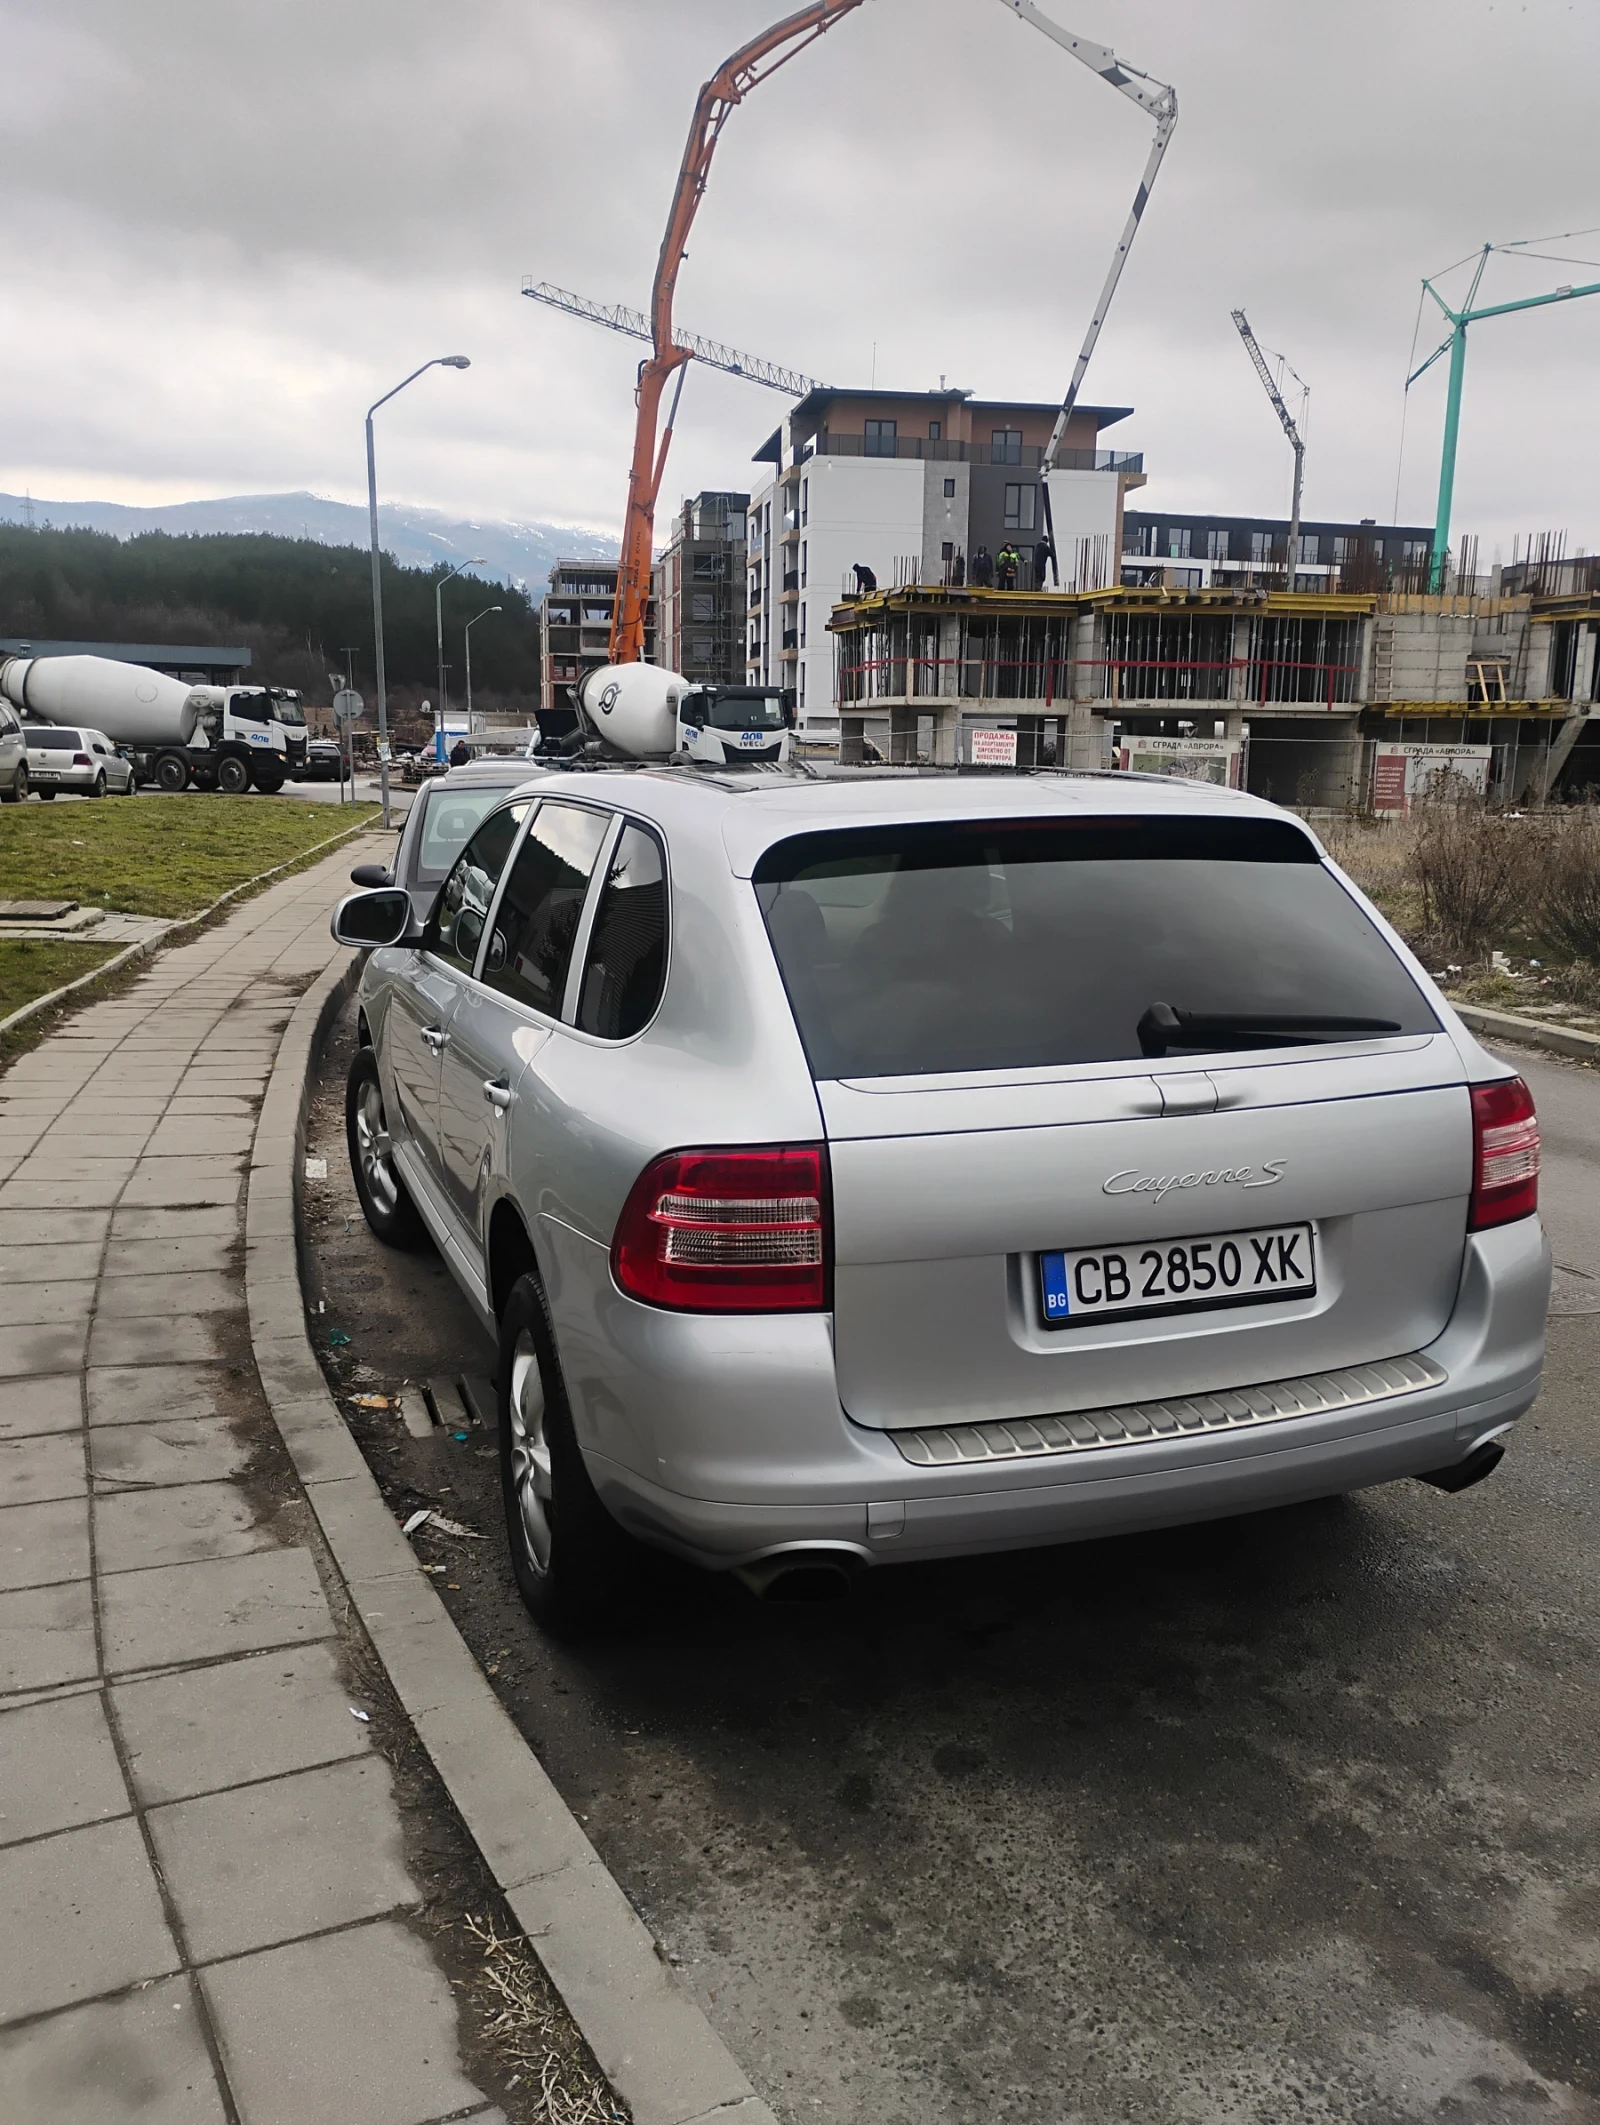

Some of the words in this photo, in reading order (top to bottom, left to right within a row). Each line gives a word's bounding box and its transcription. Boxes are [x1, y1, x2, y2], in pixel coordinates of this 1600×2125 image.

[974, 732, 1015, 740] ПРОДАЖБА
[1152, 741, 1182, 750] СГРАДА
[1403, 746, 1434, 755] СГРАДА
[1102, 1164, 1254, 1205] Cayenne
[1243, 1158, 1289, 1189] S
[1074, 1255, 1132, 1305] CB
[1138, 1240, 1243, 1298] 2850
[1249, 1233, 1306, 1285] XK
[1047, 1293, 1067, 1309] BG
